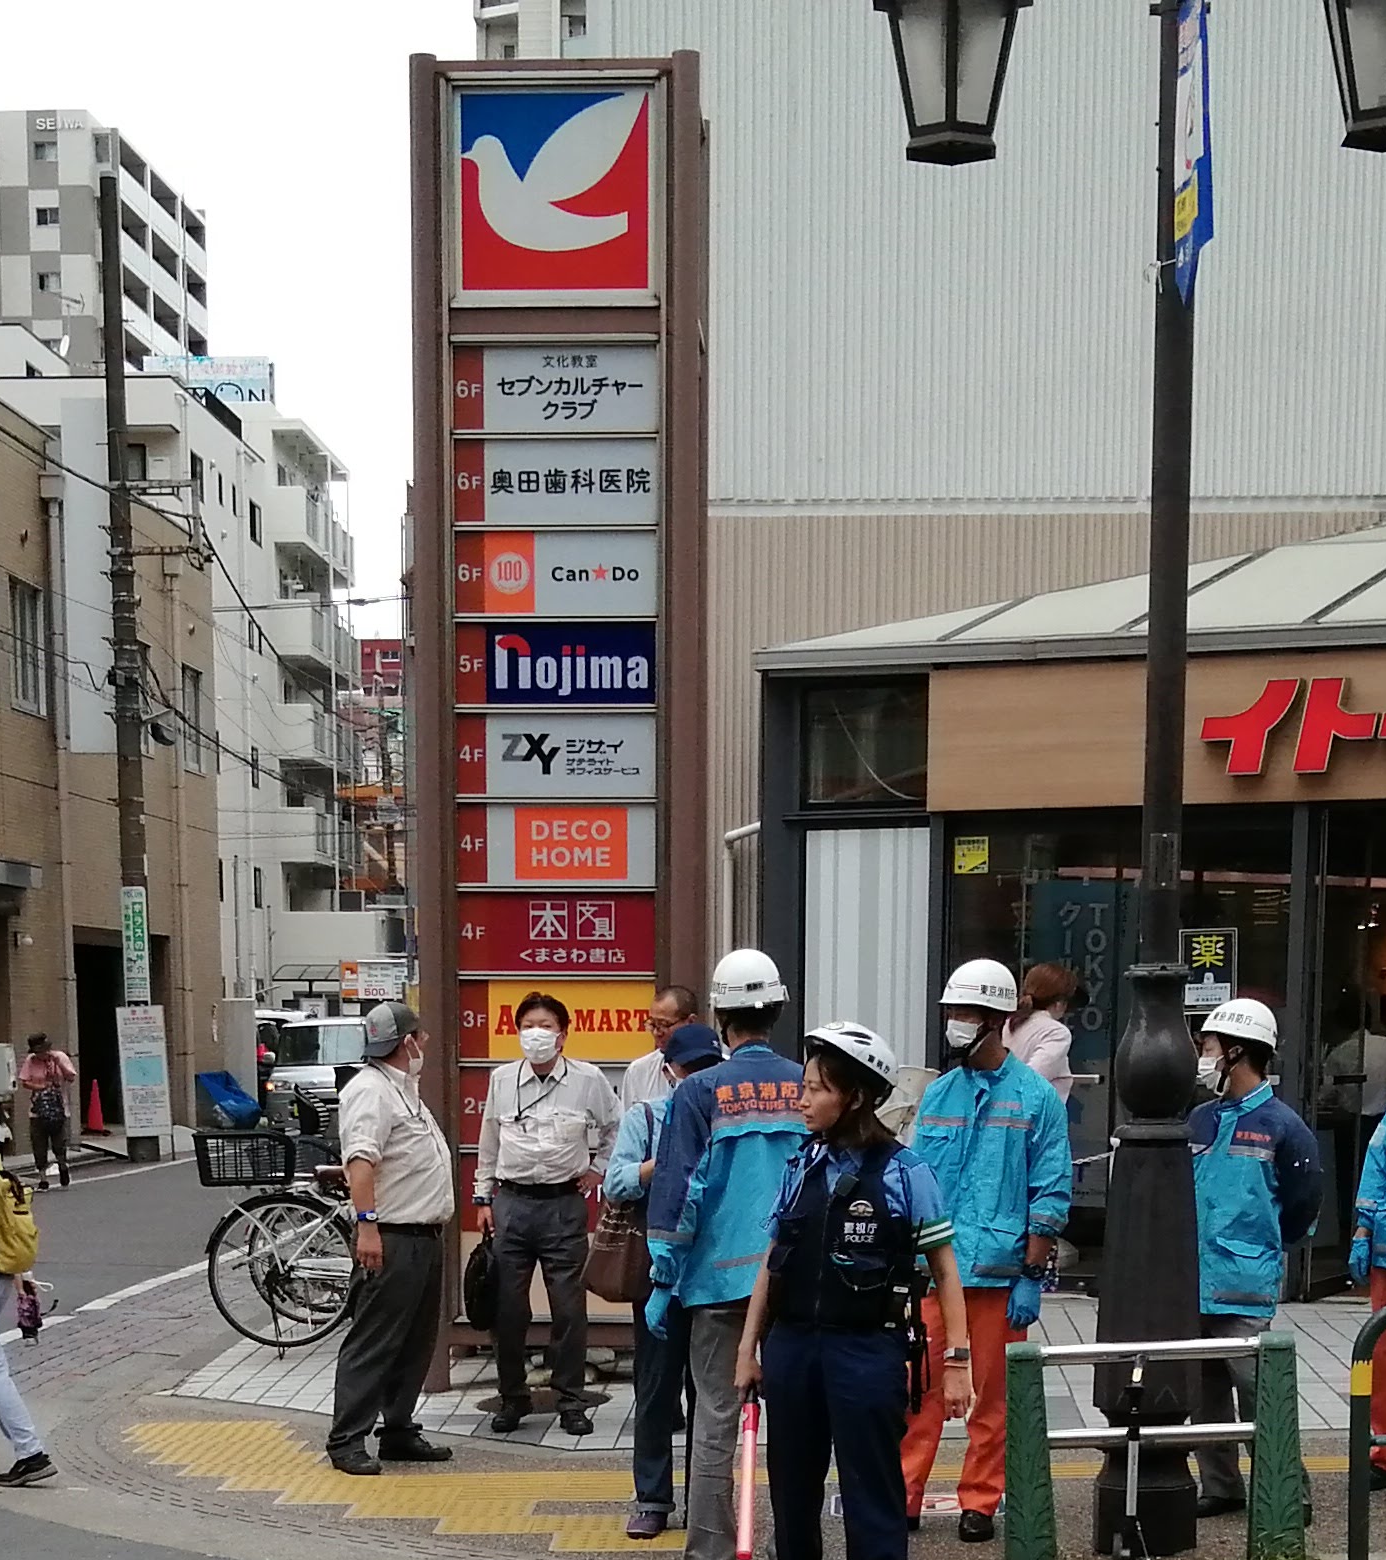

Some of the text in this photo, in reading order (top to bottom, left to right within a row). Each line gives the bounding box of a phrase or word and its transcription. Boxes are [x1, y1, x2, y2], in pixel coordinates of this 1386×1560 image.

[542, 355, 598, 368] 文化教室
[456, 380, 481, 398] 6F
[497, 376, 643, 396] セブンカルチャー
[542, 399, 598, 420] クラブ
[457, 472, 482, 490] 6F
[490, 467, 651, 494] 奥田歯科医院
[457, 563, 482, 582] 6F
[497, 560, 522, 581] 100
[459, 655, 483, 673] 5F
[495, 634, 649, 696] nojima
[459, 745, 483, 762] 4F
[502, 733, 561, 775] ZXY
[566, 739, 624, 754] ジザイ
[566, 767, 640, 775] オフィスサービス
[531, 820, 612, 840] DECO
[460, 835, 484, 852] 4F
[531, 847, 612, 867] HOME
[461, 922, 485, 940] 4F
[520, 948, 626, 963] くまさわ書店
[1192, 935, 1225, 968] 薬
[1081, 903, 1109, 1031] TOKYO
[463, 1010, 487, 1028] 3F
[495, 1005, 650, 1035] A-MART
[844, 1235, 875, 1243] POLICE
